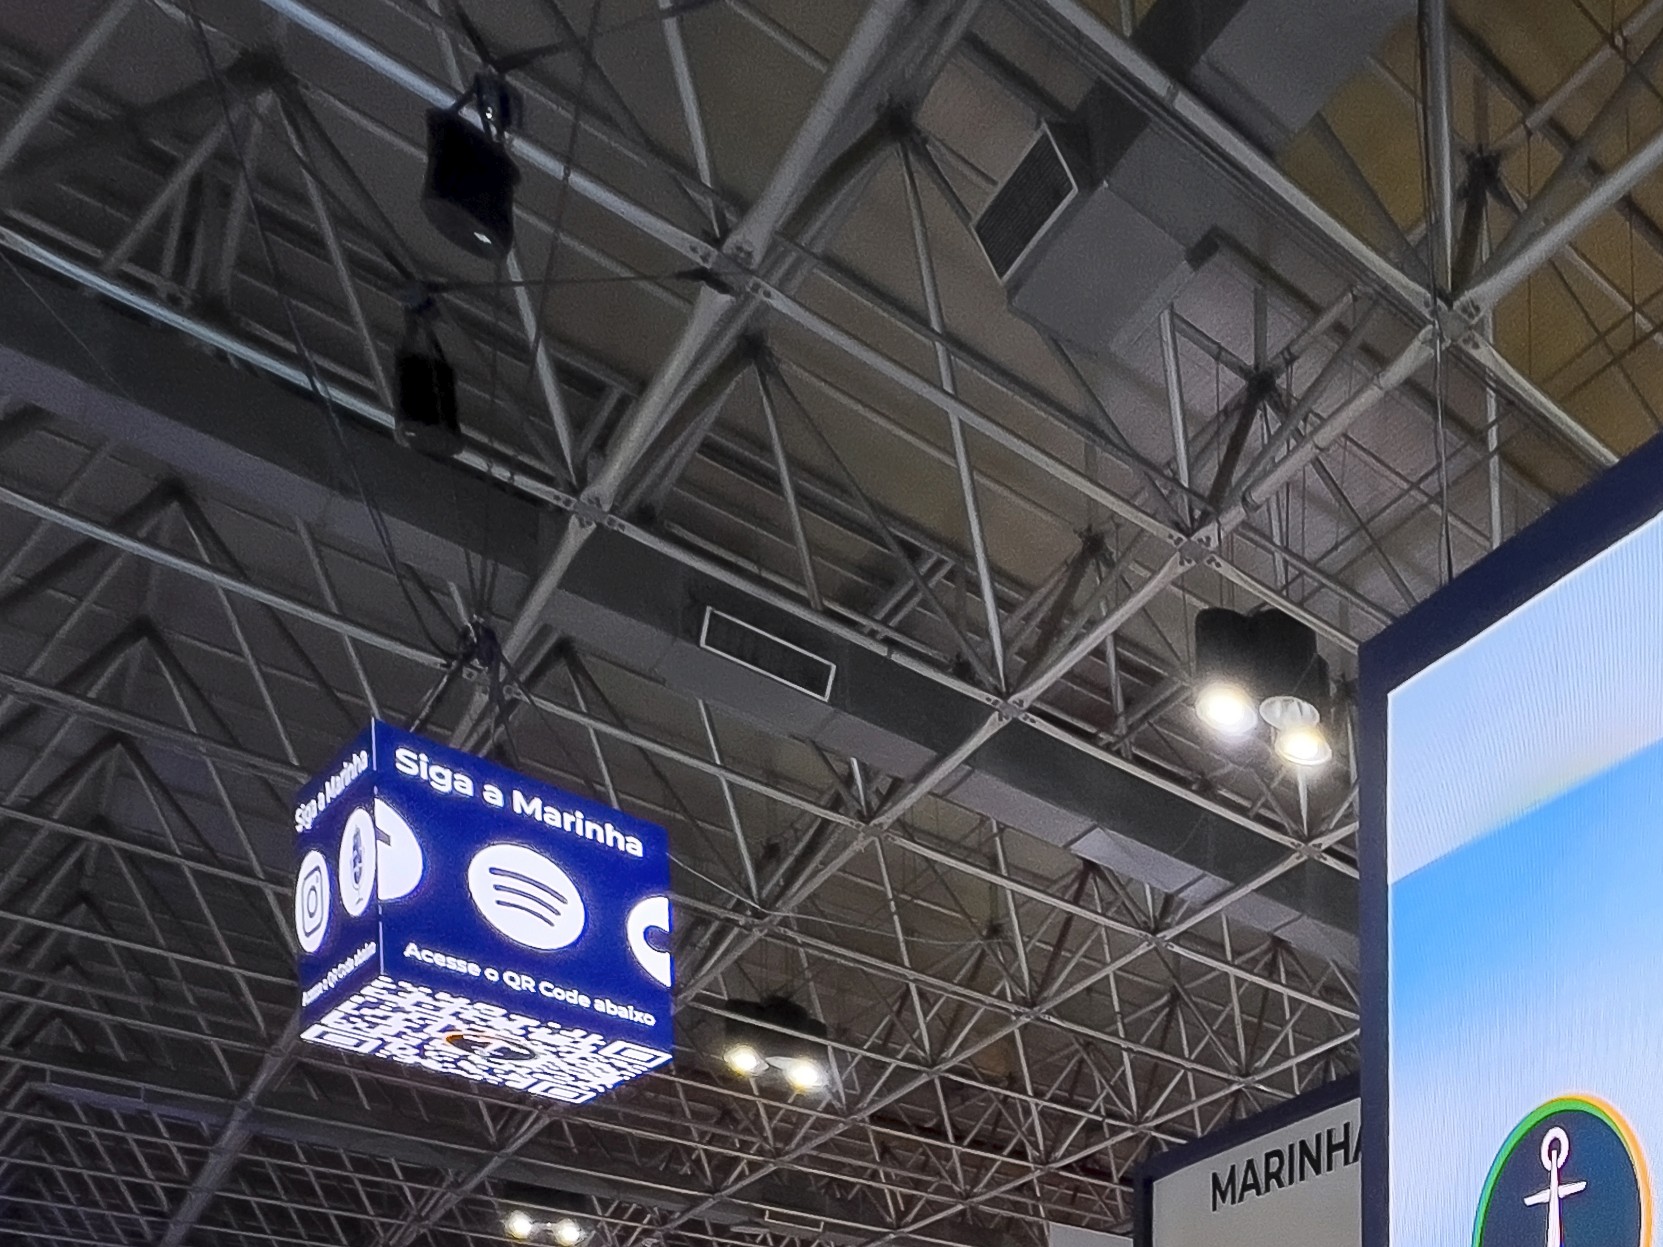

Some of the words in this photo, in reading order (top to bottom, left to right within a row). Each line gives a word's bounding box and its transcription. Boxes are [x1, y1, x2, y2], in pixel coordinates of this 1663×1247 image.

[395, 748, 474, 796] Siga
[482, 783, 505, 807] a
[512, 790, 643, 857] Marinha
[403, 942, 482, 977] Acesse
[484, 967, 500, 982] o
[503, 970, 536, 993] QR
[538, 981, 592, 1008] Code
[594, 999, 657, 1027] abaixo
